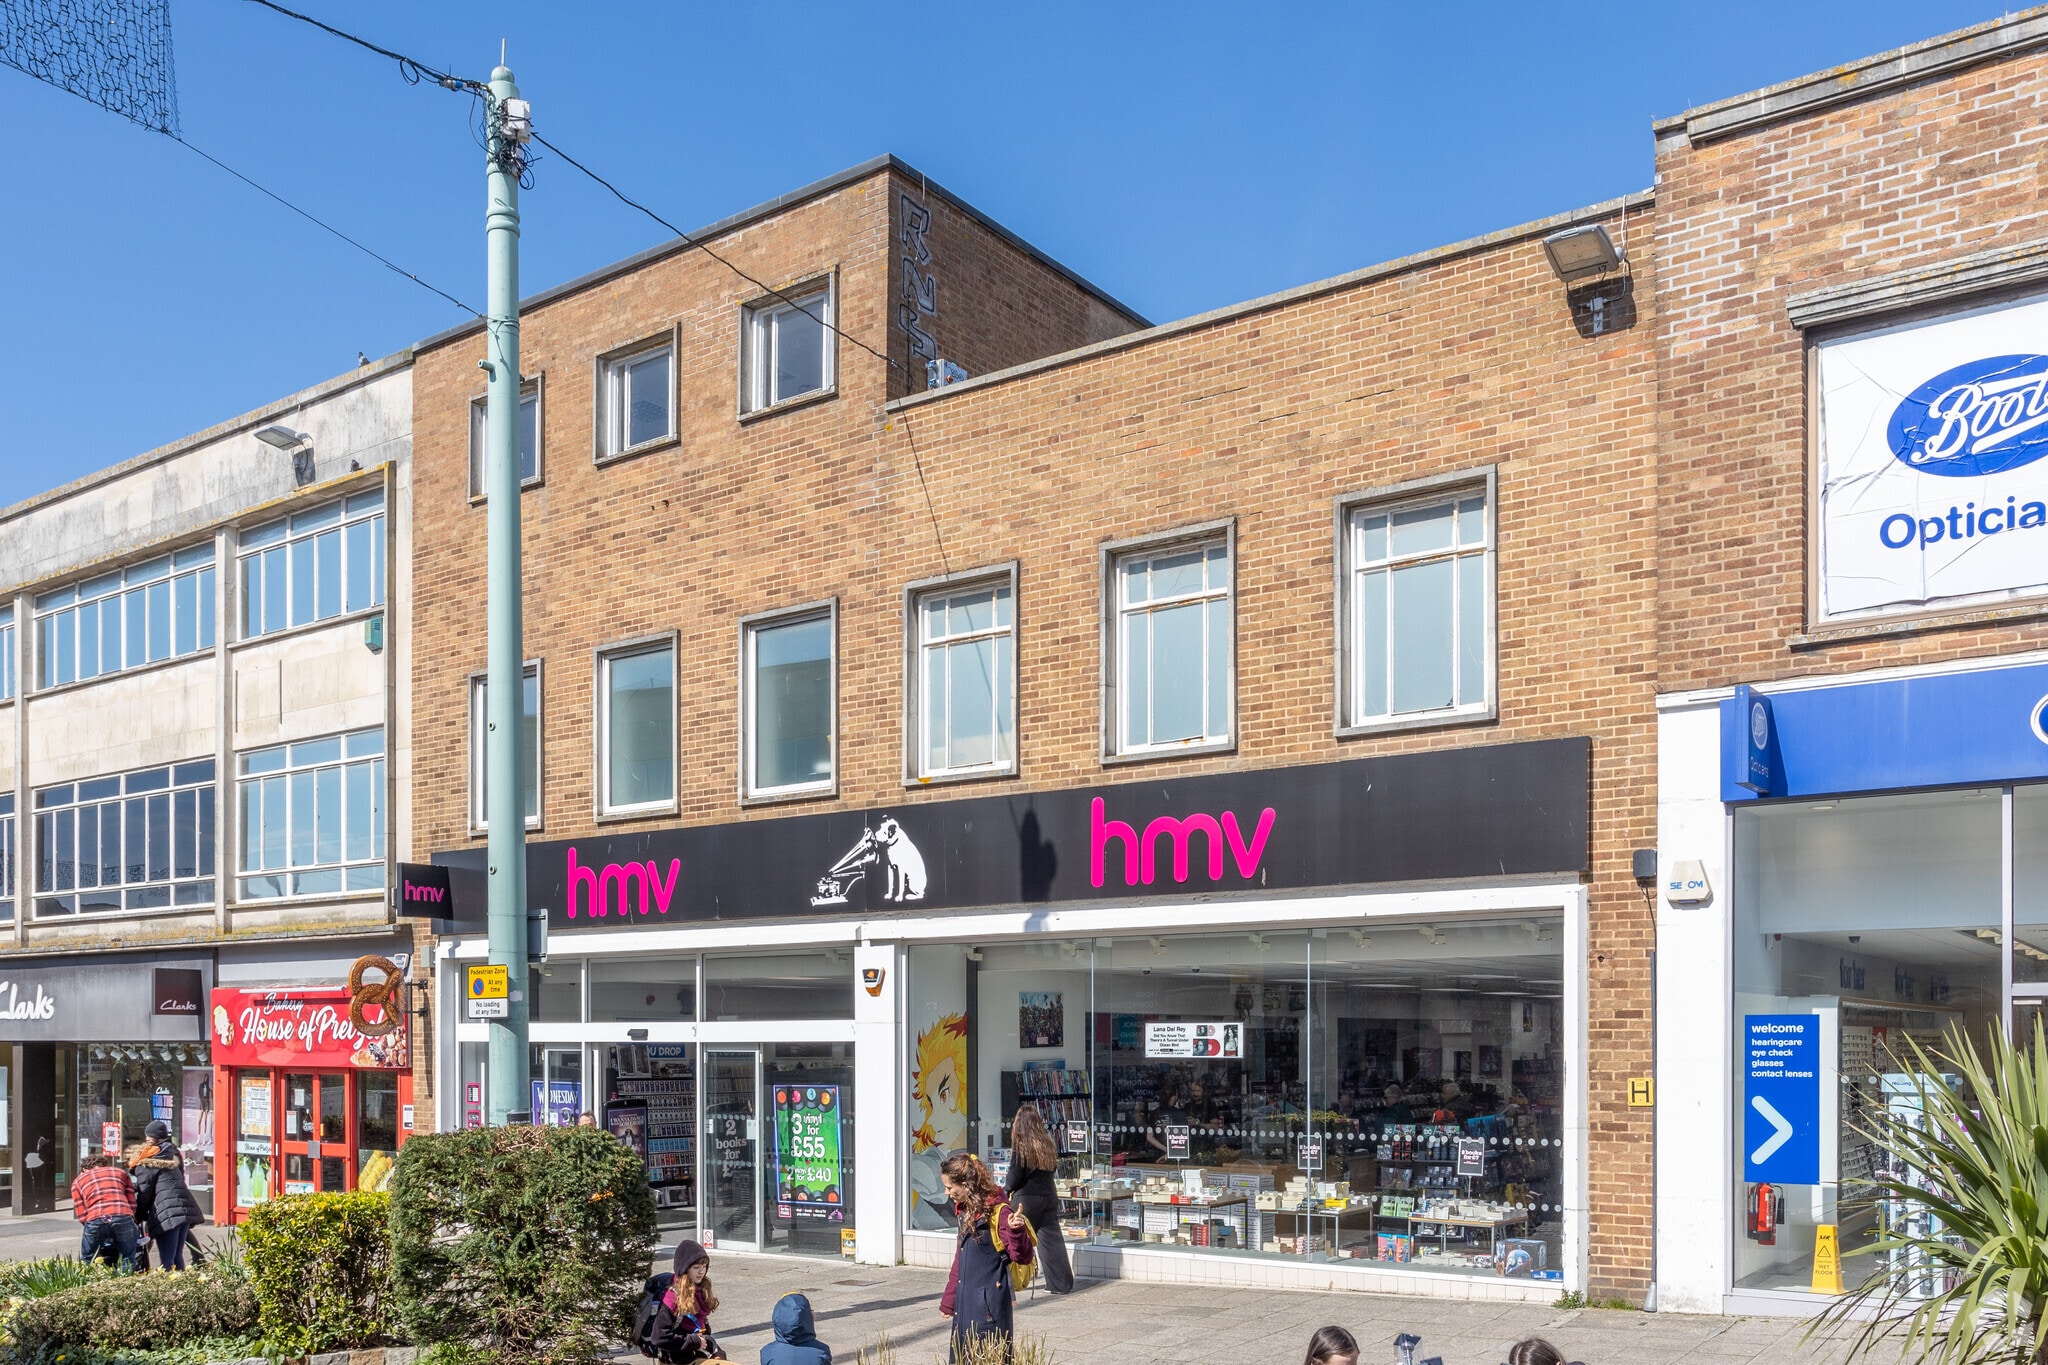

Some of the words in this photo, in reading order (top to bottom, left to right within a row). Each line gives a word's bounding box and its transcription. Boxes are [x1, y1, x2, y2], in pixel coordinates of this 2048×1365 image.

[1091, 796, 1277, 888] hmv
[404, 879, 445, 903] hmv
[567, 846, 681, 919] hmv
[160, 1000, 197, 1011] Clarks
[263, 992, 305, 1018] Bakery
[239, 1005, 294, 1045] House
[299, 1010, 317, 1052] of
[1751, 1022, 1804, 1033] welcome
[658, 1046, 682, 1056] DROP
[1751, 1038, 1803, 1047] hearingcare
[1751, 1050, 1766, 1058] eye
[1768, 1048, 1794, 1056] check
[1751, 1059, 1784, 1068] glasses
[1631, 1080, 1650, 1103] H
[725, 1119, 737, 1136] 2
[791, 1112, 803, 1135] 3
[803, 1113, 823, 1125] vinyl
[807, 1125, 820, 1136] for
[715, 1136, 748, 1150] books
[791, 1135, 826, 1159] £55
[724, 1148, 741, 1160] for
[786, 1166, 795, 1181] 2
[807, 1166, 832, 1183] £40
